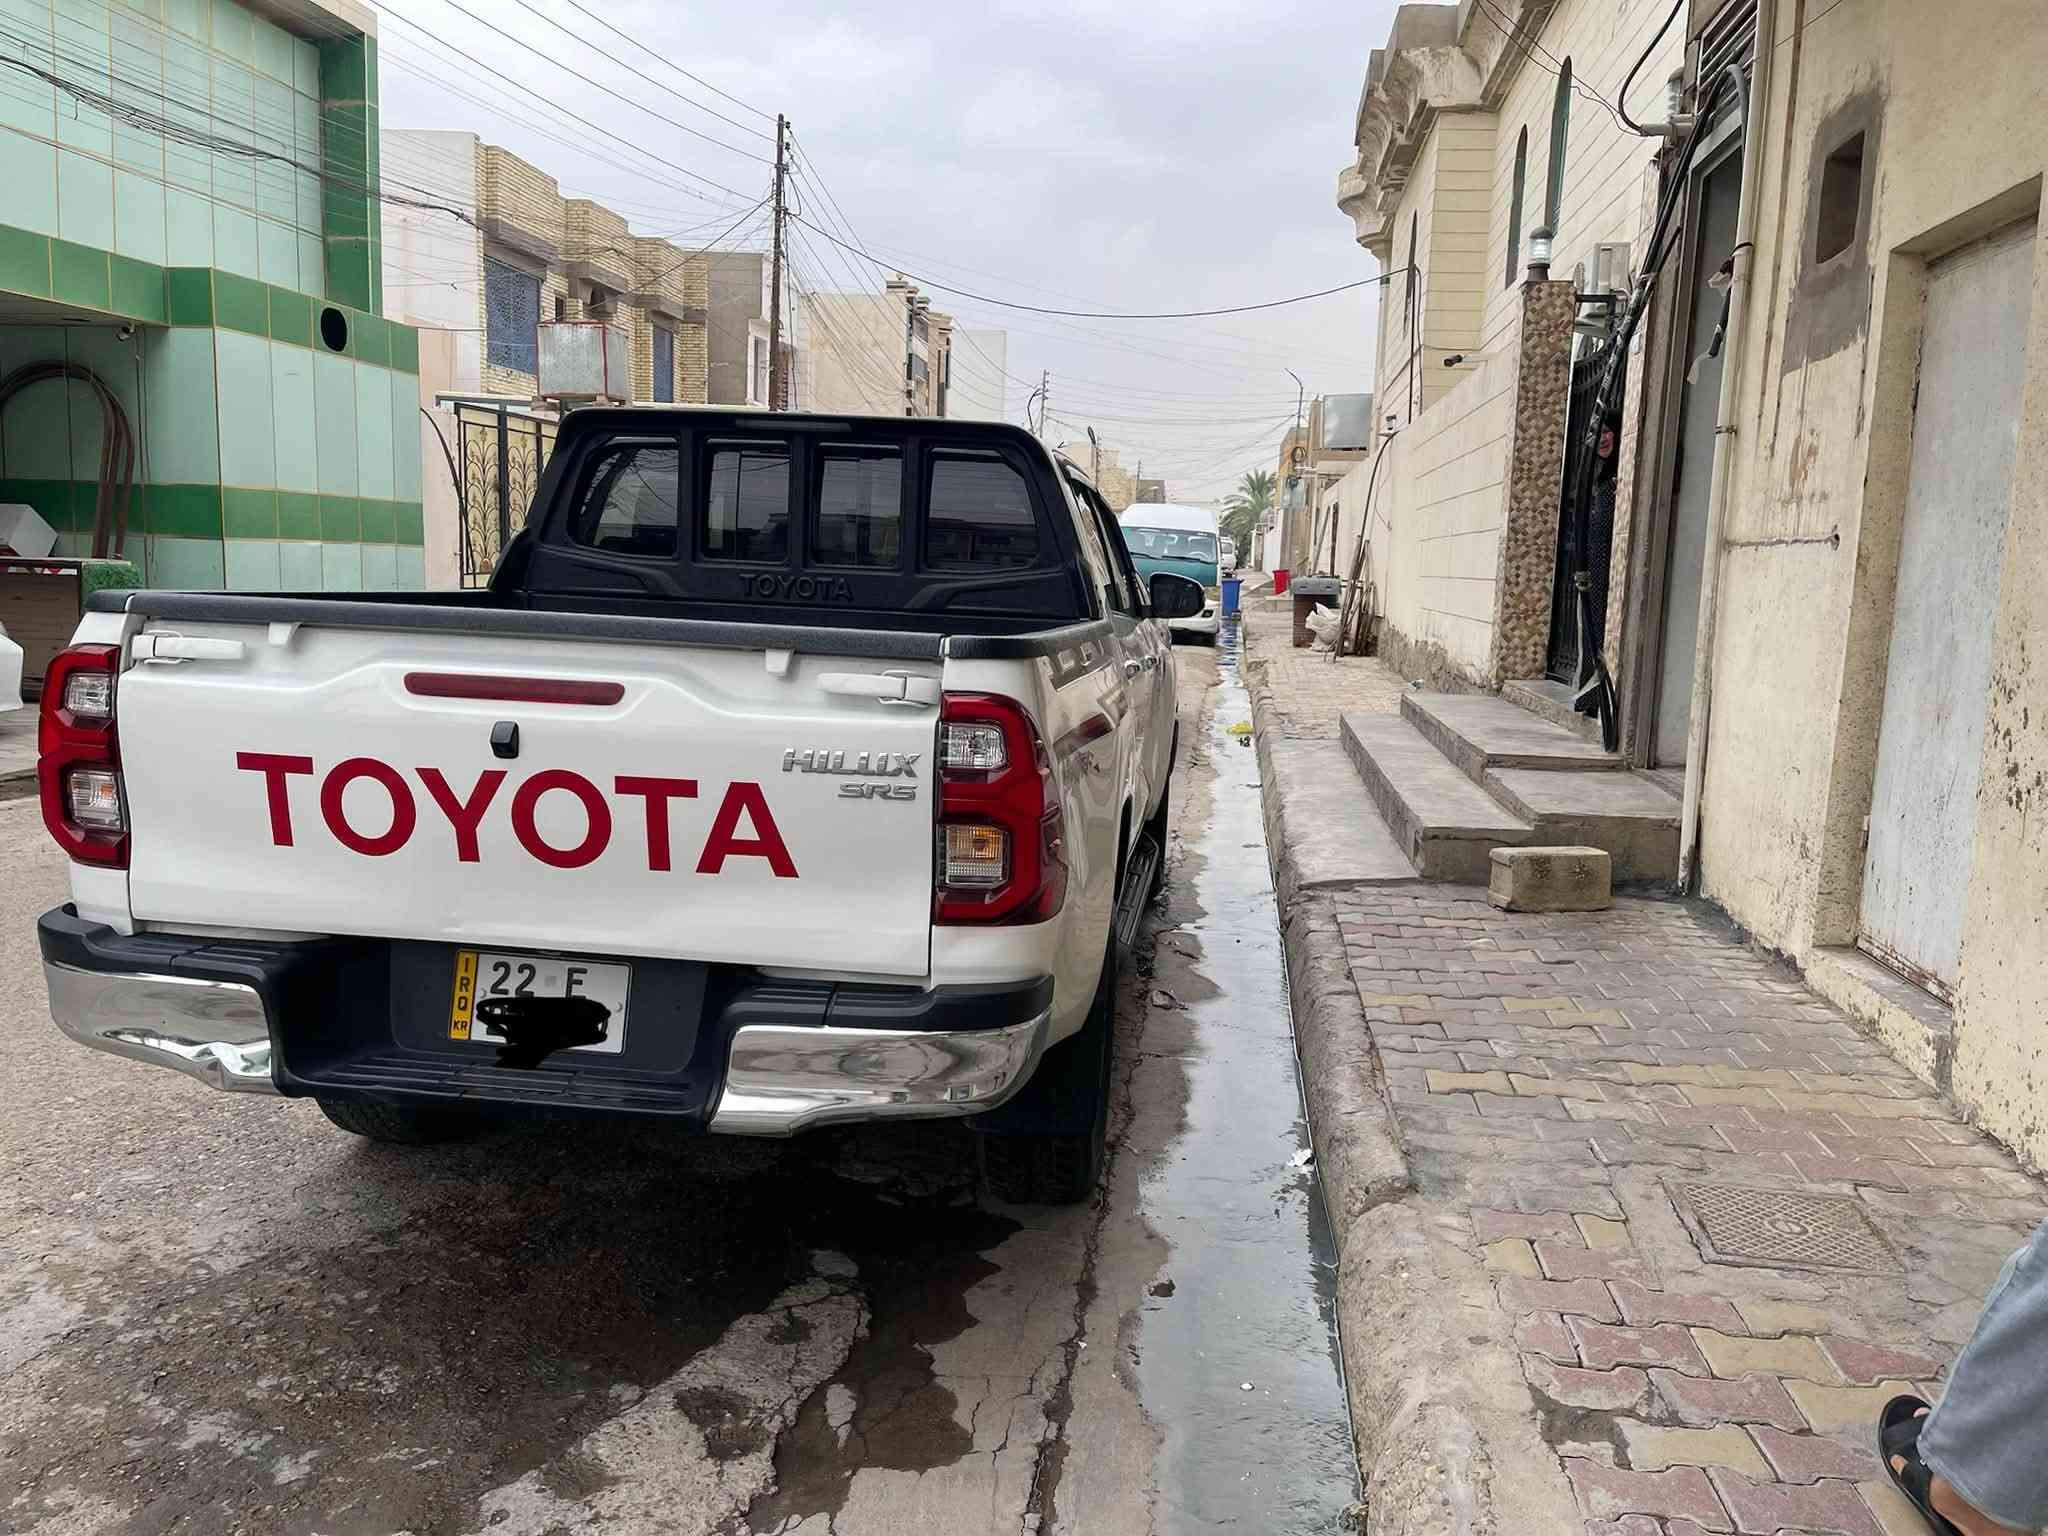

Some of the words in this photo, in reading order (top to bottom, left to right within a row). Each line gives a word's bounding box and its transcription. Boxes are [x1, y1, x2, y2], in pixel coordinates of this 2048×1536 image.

[739, 573, 854, 600] TOYOTA
[782, 748, 920, 777] HILUX
[236, 752, 799, 878] TOYOTA
[490, 961, 536, 997] 22
[453, 1019, 468, 1032] KR
